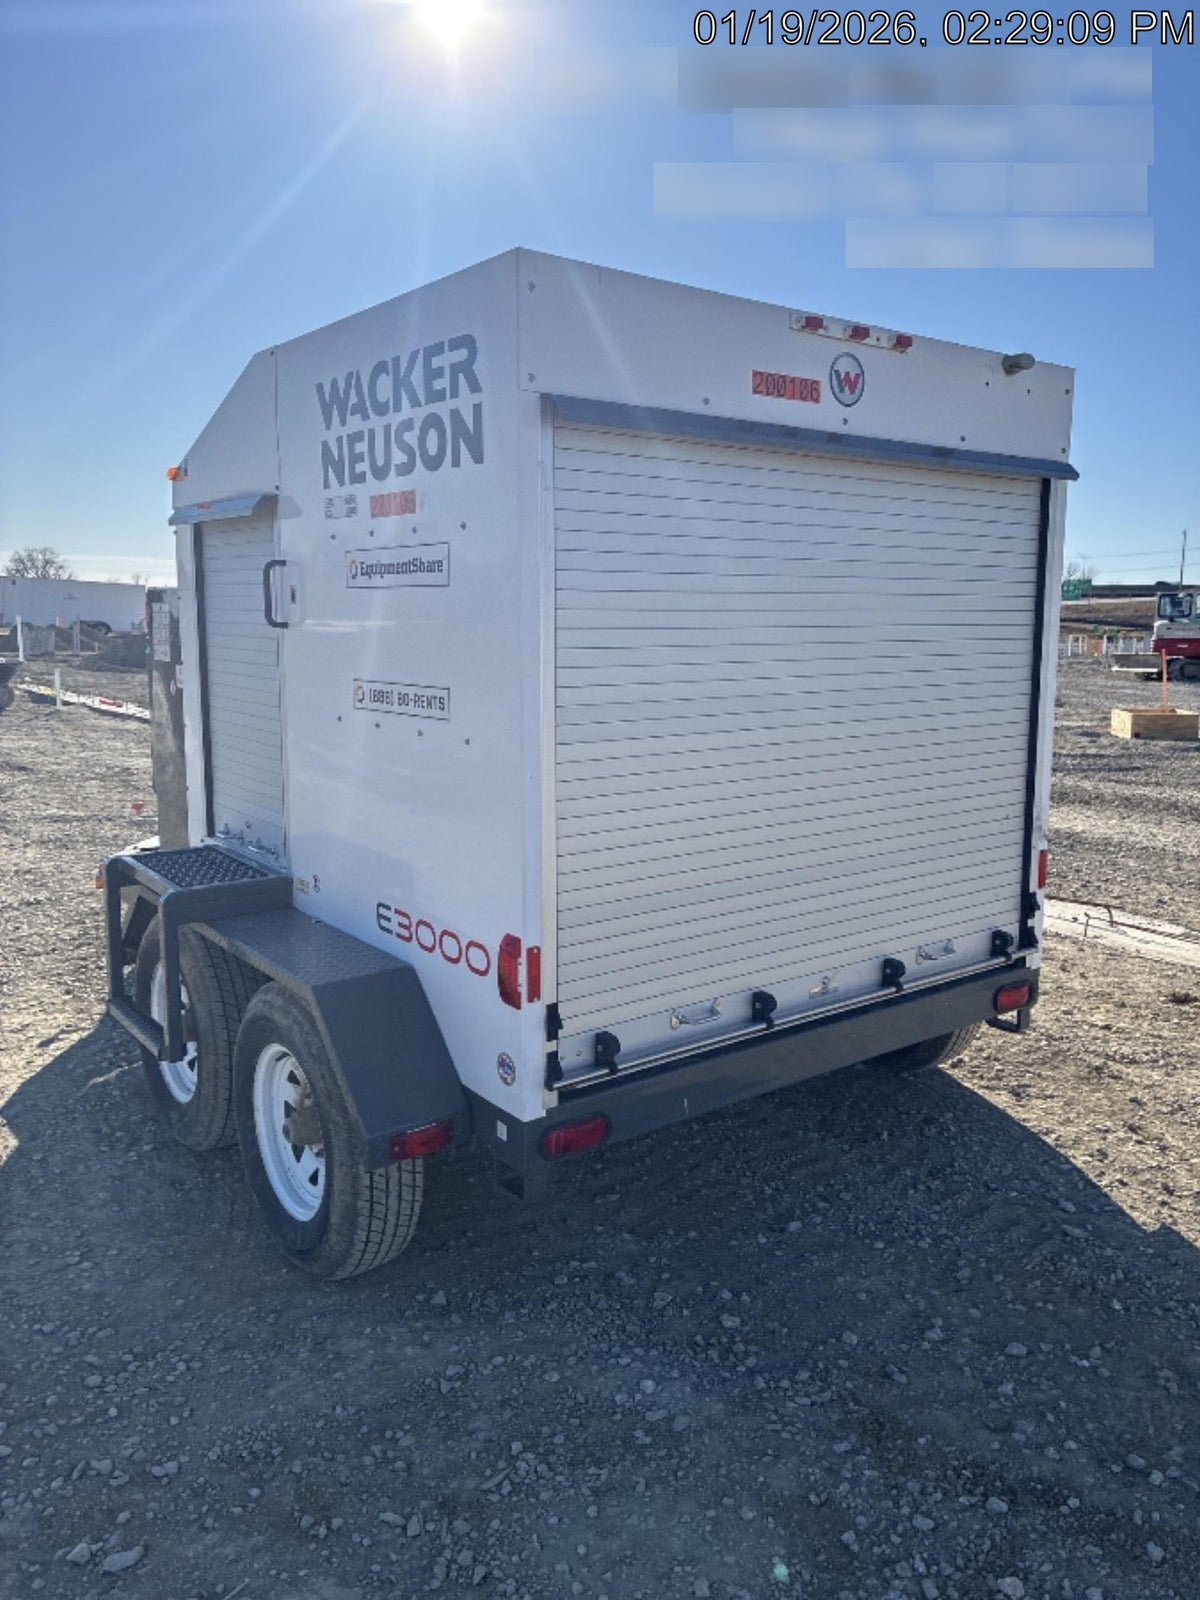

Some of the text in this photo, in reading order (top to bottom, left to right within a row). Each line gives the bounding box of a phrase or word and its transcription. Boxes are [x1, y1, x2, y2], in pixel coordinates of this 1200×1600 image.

[315, 333, 483, 431] WACKER
[321, 402, 484, 490] NEUSON
[359, 557, 444, 579] EquipmentShare
[376, 902, 491, 977] E3000
